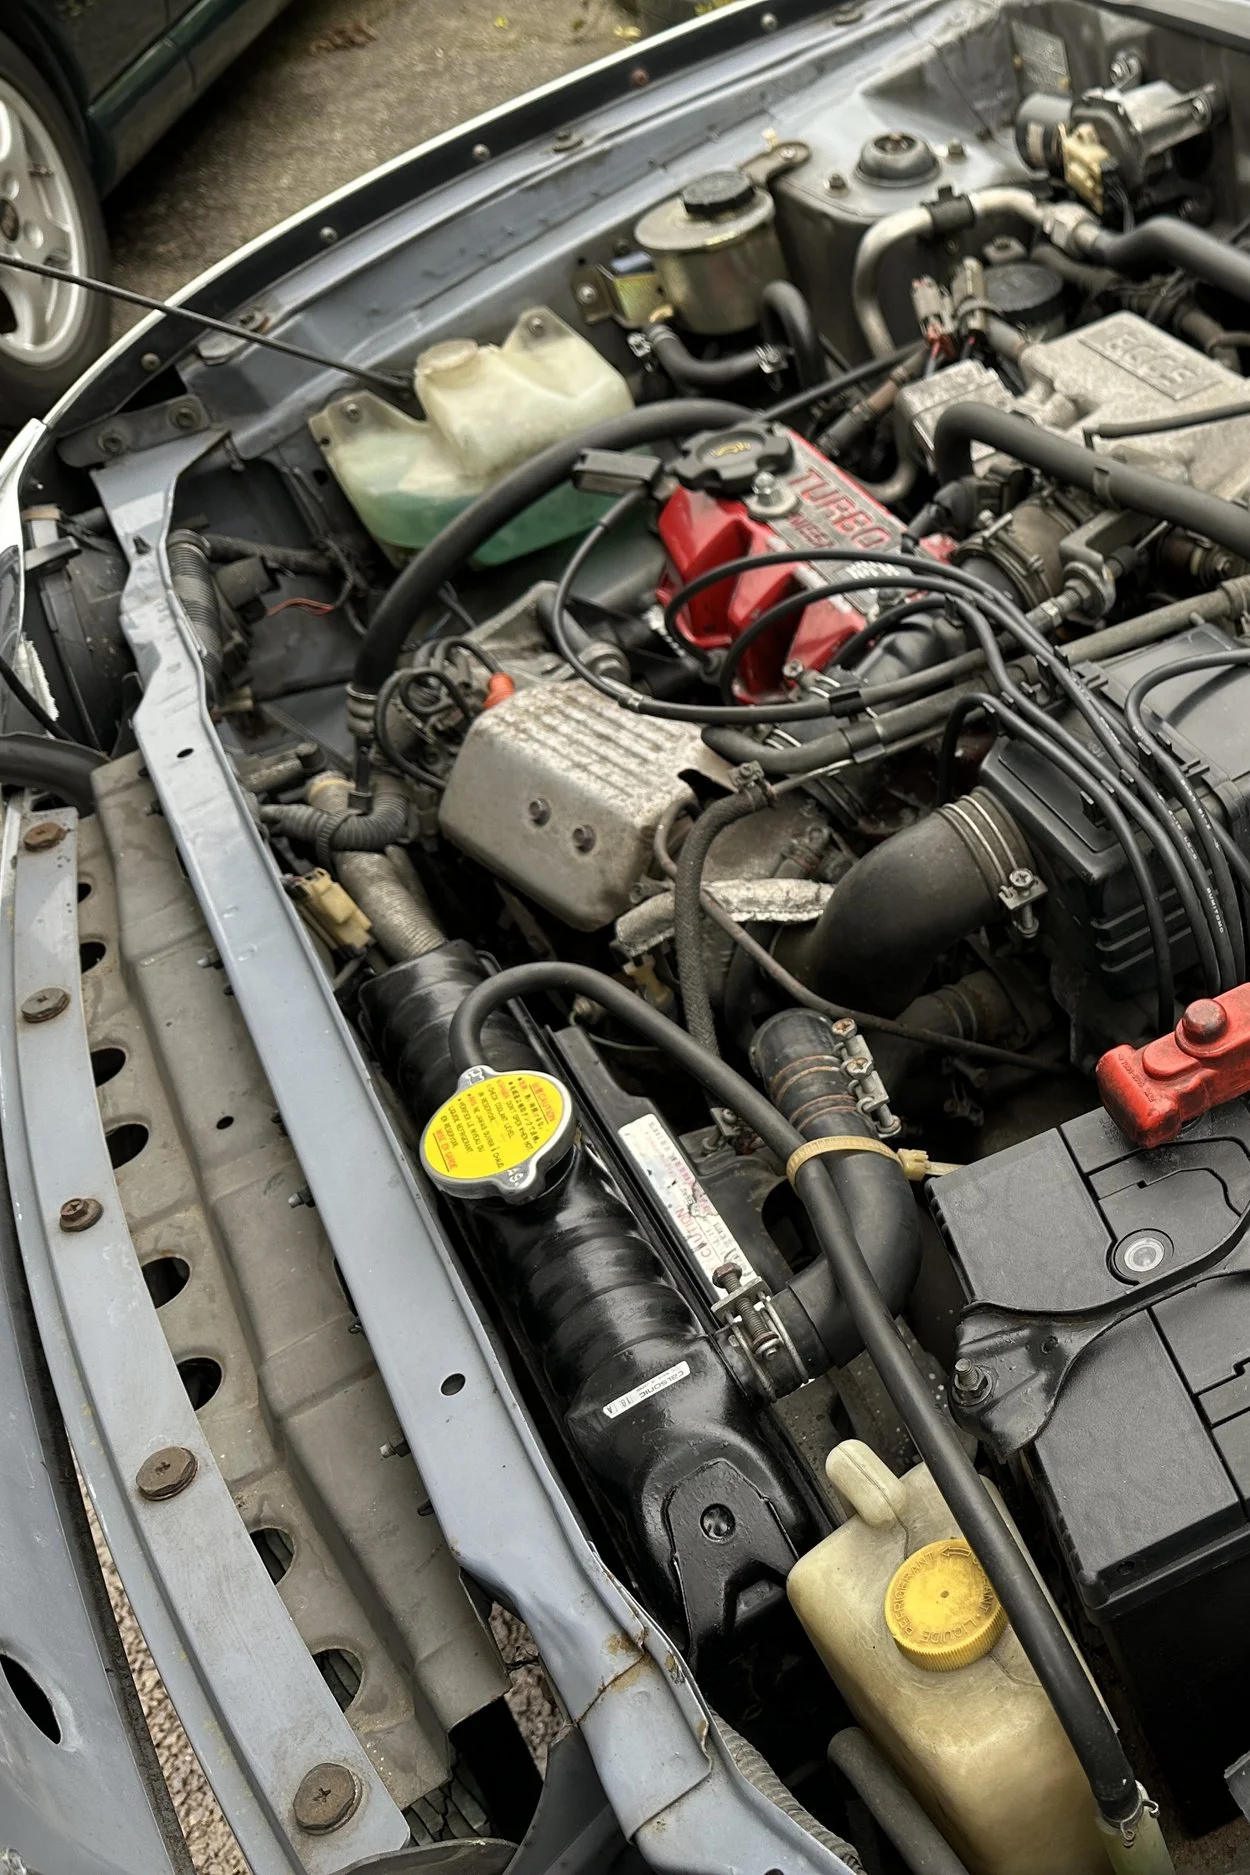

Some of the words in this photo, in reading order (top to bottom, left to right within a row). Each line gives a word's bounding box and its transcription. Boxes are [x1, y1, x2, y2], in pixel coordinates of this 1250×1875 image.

[789, 468, 891, 548] TURBO
[893, 1551, 934, 1636] REFRIGERANT
[920, 1619, 977, 1643] LIQUIDE
